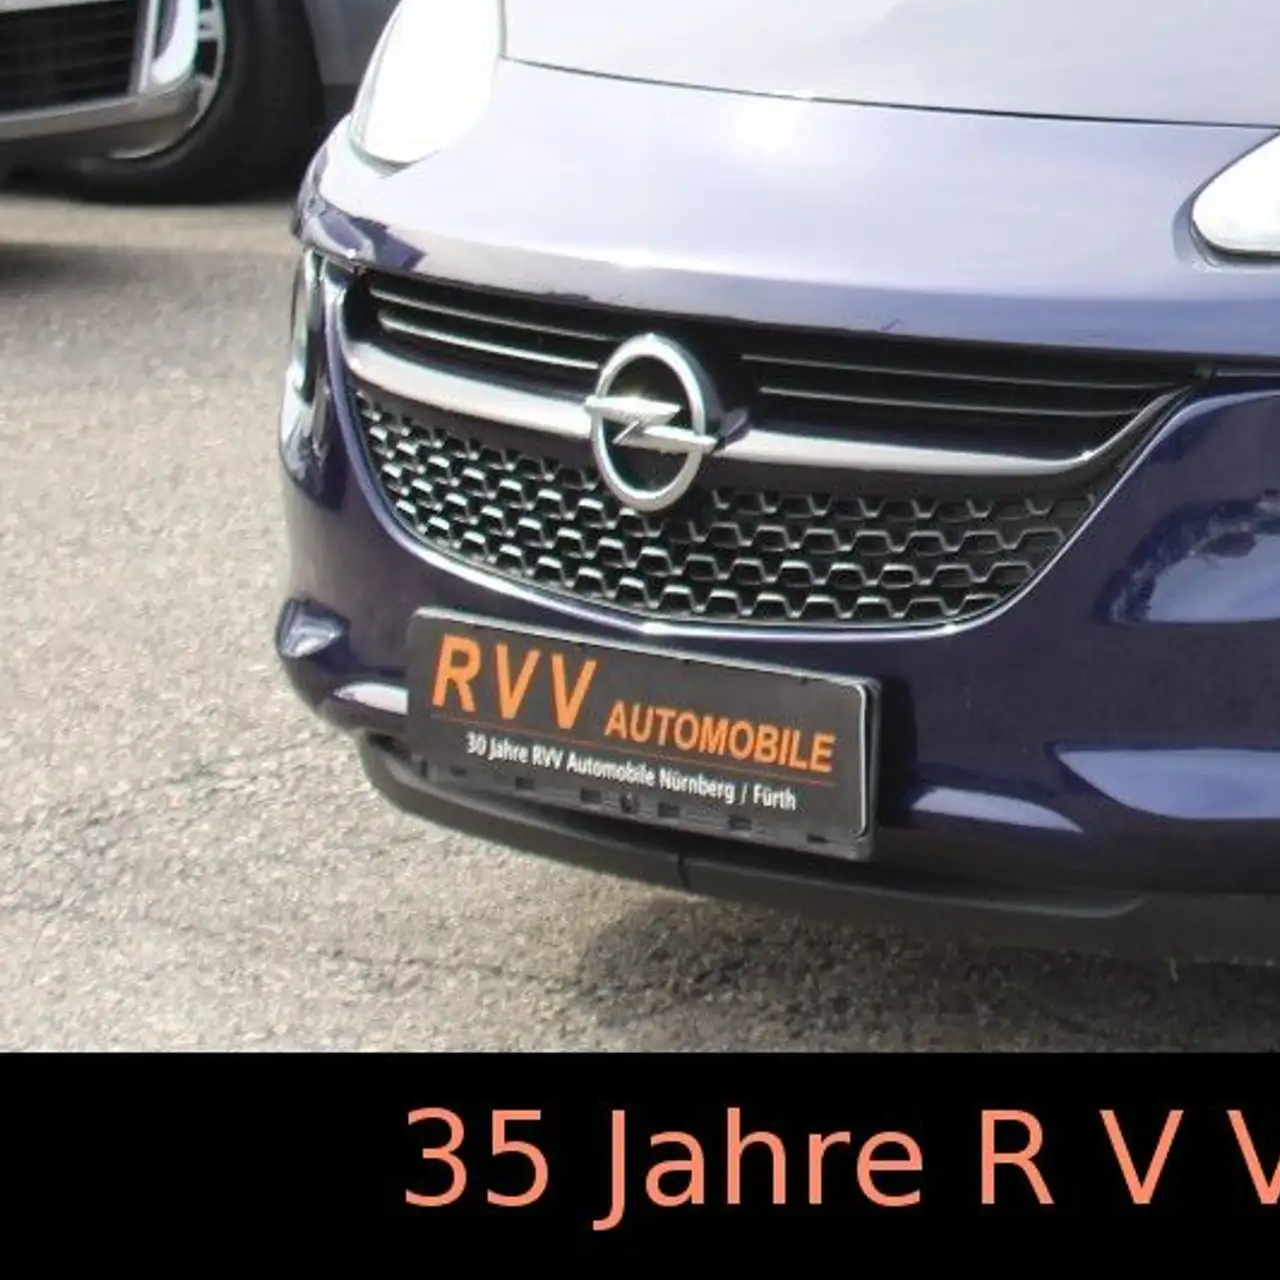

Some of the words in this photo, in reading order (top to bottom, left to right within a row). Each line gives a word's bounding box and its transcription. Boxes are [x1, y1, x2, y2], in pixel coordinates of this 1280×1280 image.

[465, 730, 488, 756] 30
[487, 736, 529, 764] Jahre
[532, 743, 564, 770] RVV
[566, 751, 656, 787] Automobile
[658, 768, 736, 805] Nürnberg
[739, 781, 749, 805] /
[753, 784, 797, 811] Fürth
[603, 699, 835, 773] AUTOMOBILE
